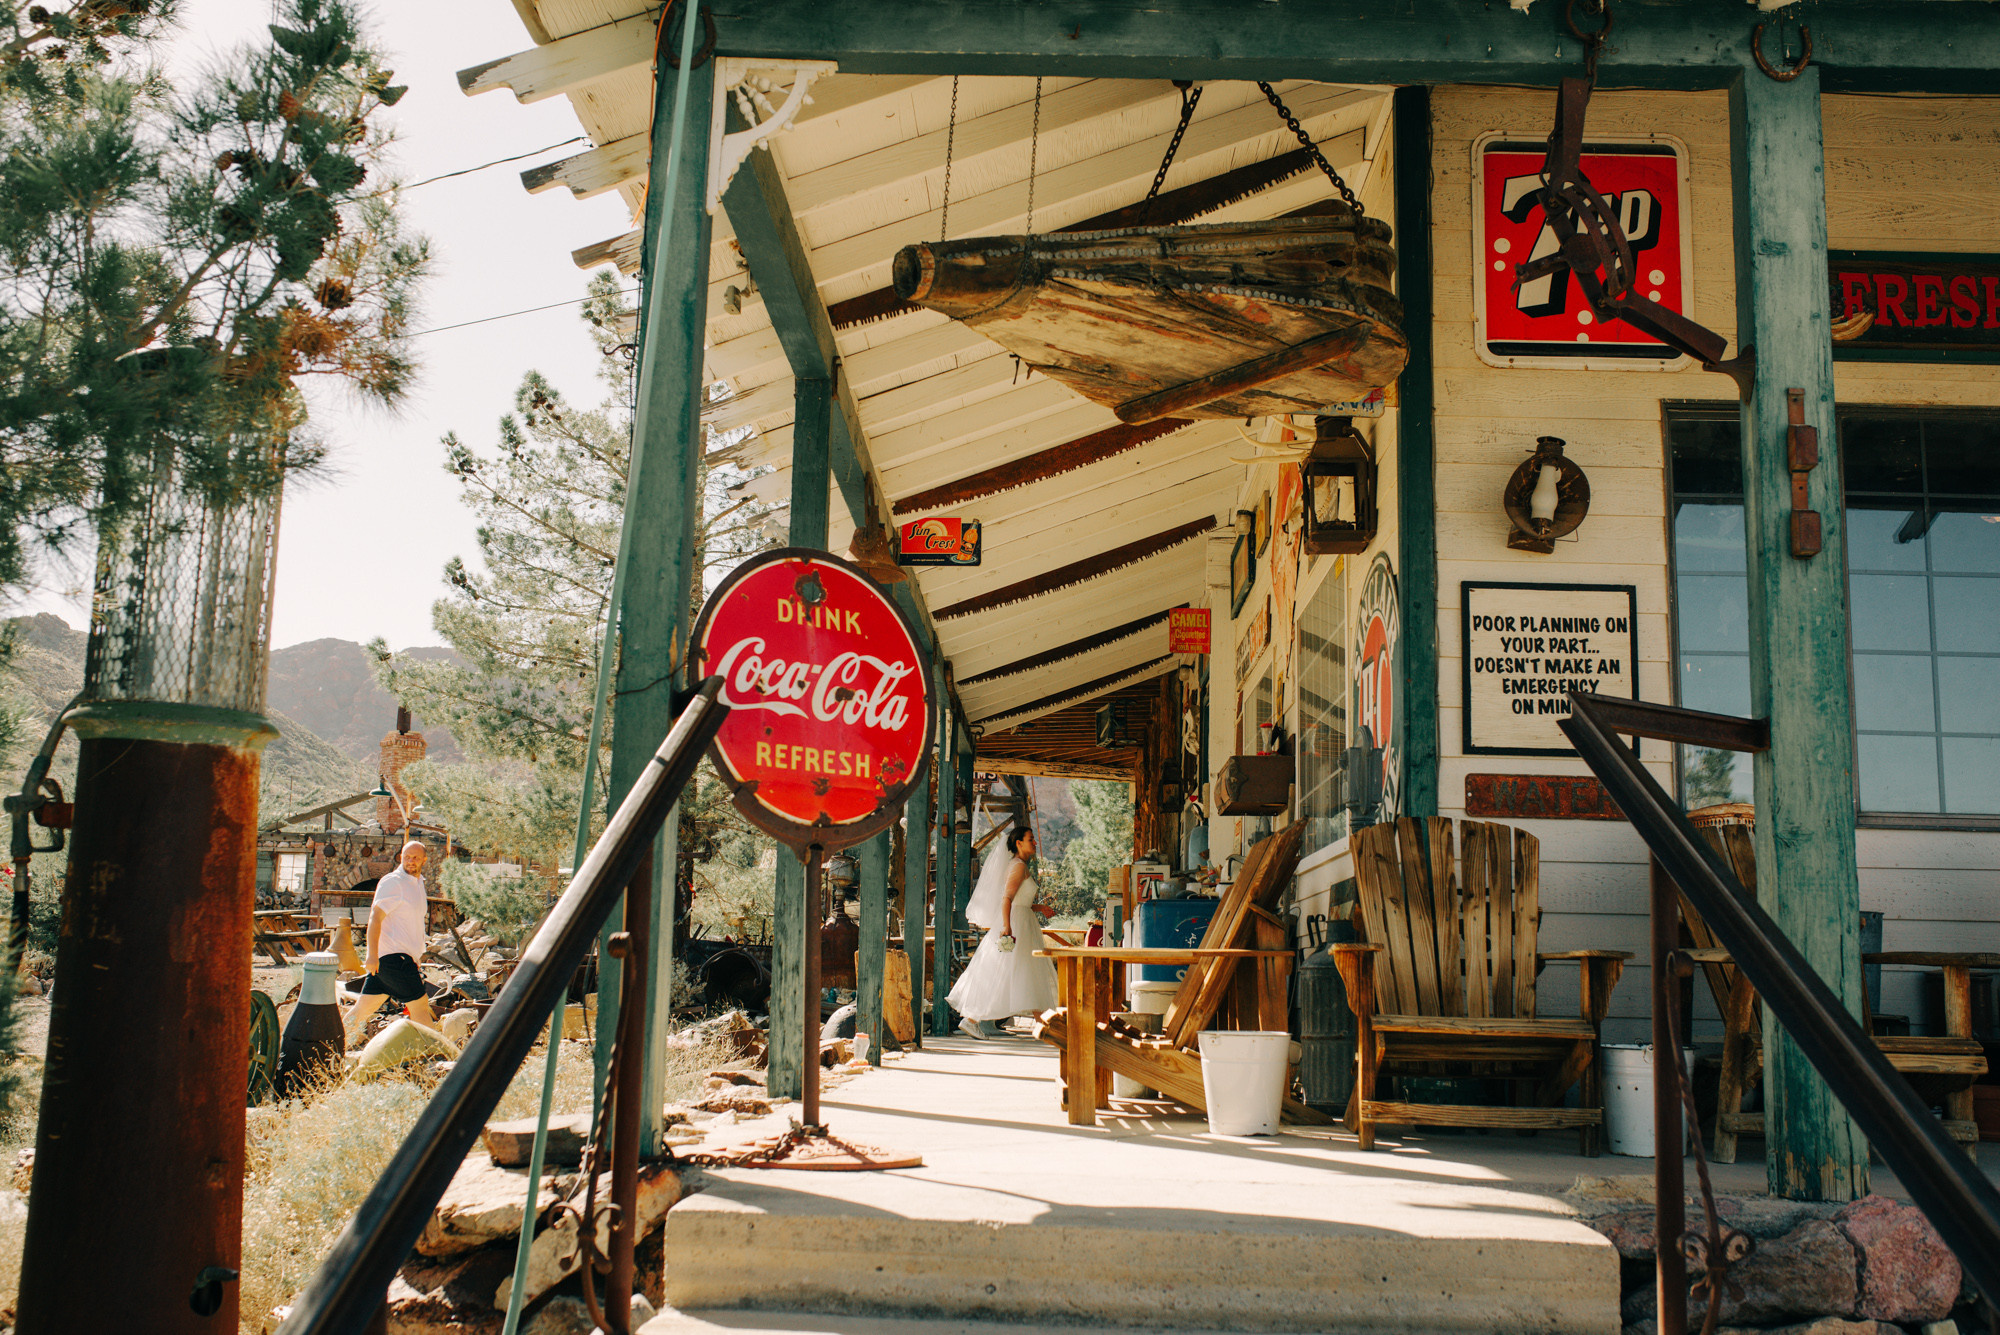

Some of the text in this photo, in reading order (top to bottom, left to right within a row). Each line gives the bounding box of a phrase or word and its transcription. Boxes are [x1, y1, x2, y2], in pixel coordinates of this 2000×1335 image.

[908, 523, 930, 539] Sun
[925, 533, 955, 549] Crest
[777, 598, 862, 635] DRINK
[1171, 613, 1208, 628] CAMEL
[1473, 615, 1628, 633] POOR PLANNING ON
[1175, 629, 1205, 640] Cigarettes
[1500, 637, 1600, 654] YOUR PART...
[1474, 657, 1620, 674] DOESN'T MAKE AN
[715, 637, 915, 731] Coca-Cola
[1502, 678, 1600, 694] EMERGENCY
[1512, 698, 1573, 714] ON MIN
[756, 741, 871, 778] REFRESH
[1492, 780, 1619, 813] WATER
